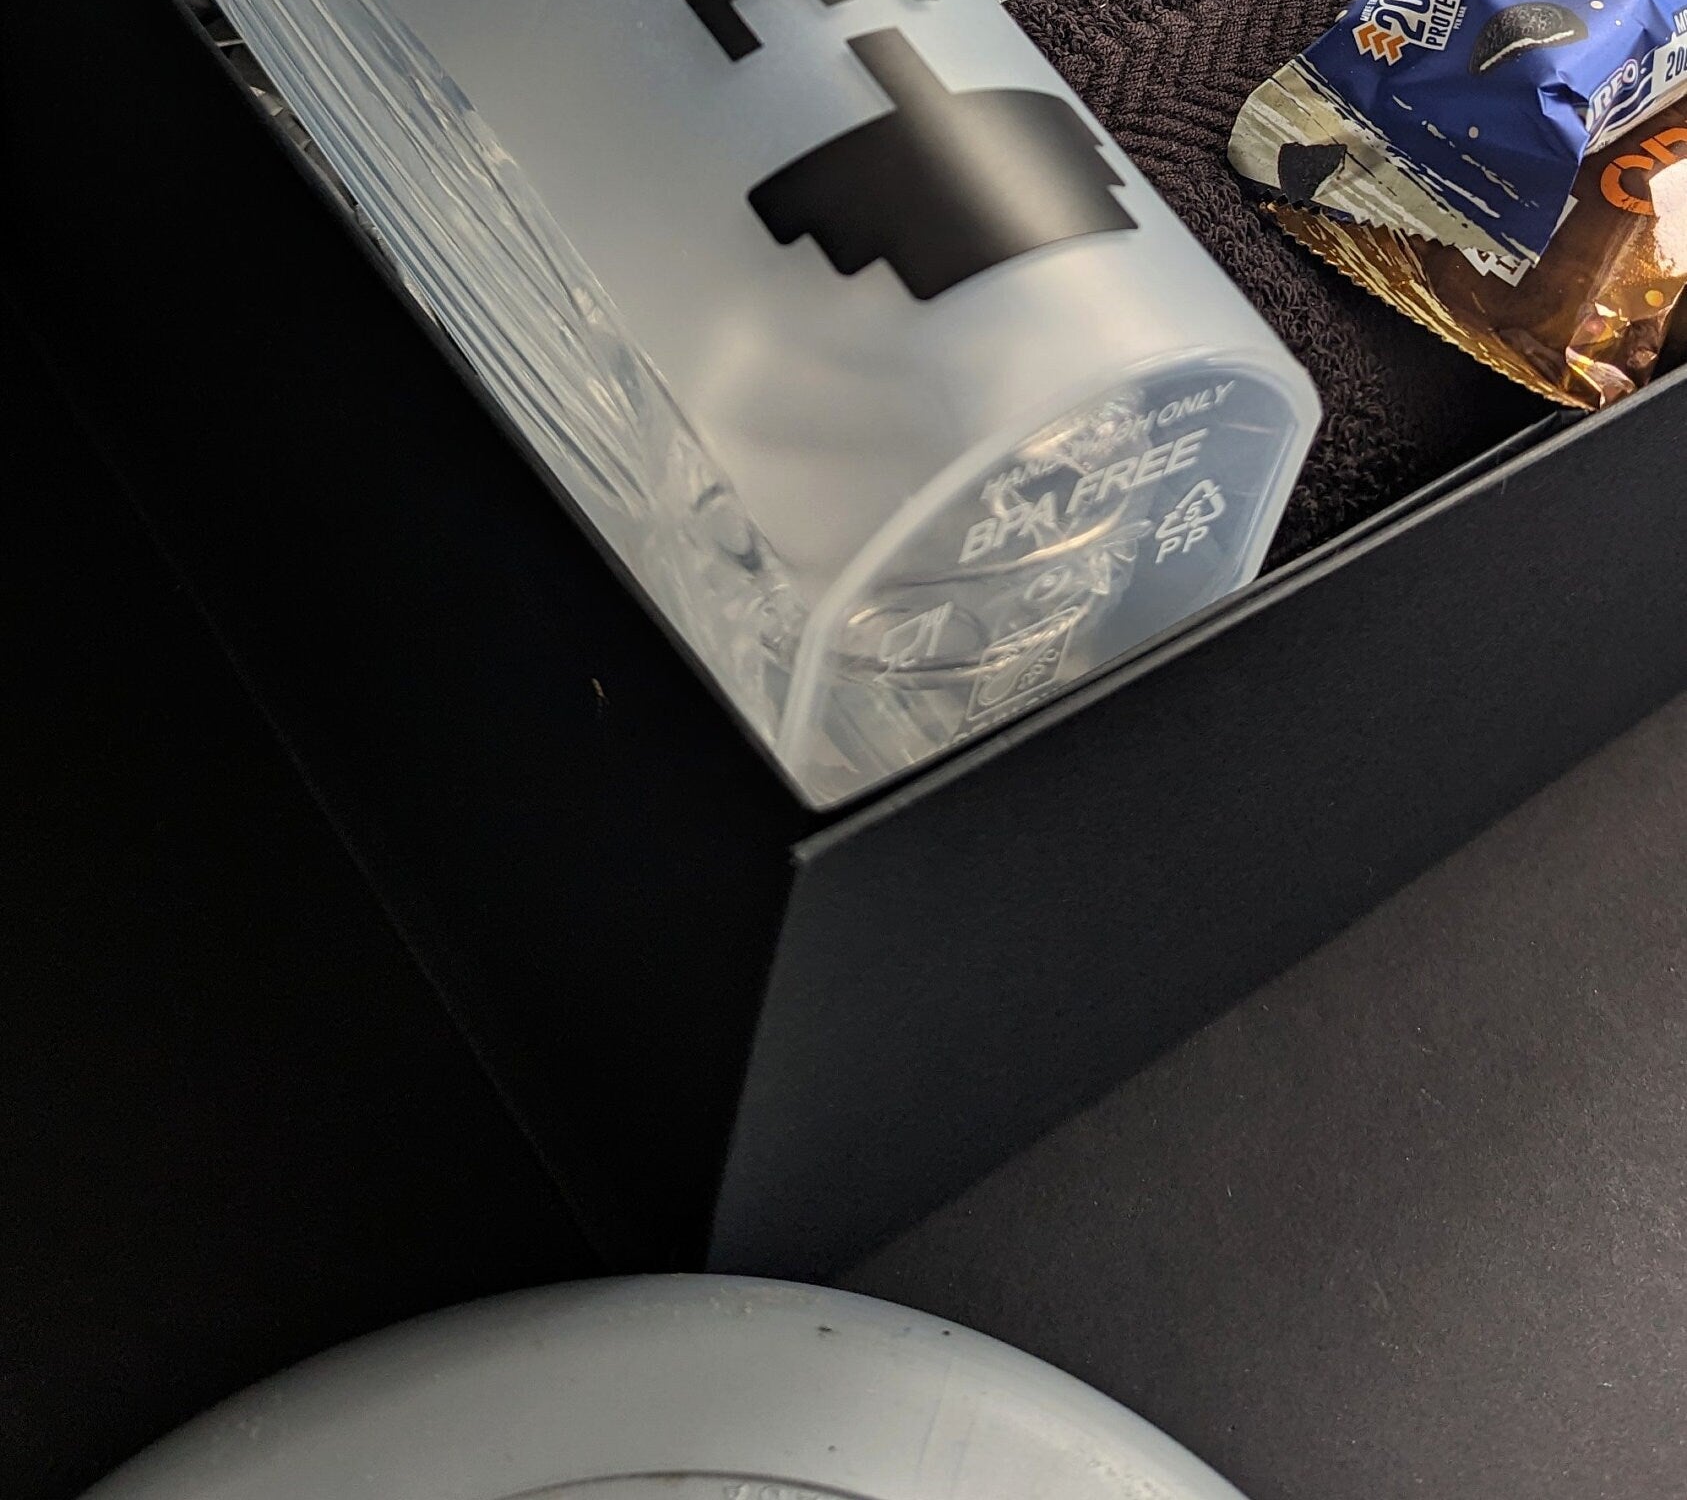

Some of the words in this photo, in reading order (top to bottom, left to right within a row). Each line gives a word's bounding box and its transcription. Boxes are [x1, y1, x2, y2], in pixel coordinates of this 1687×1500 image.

[1157, 380, 1236, 426] ONLY
[1065, 427, 1209, 514] FREE
[1155, 526, 1209, 564] PP
